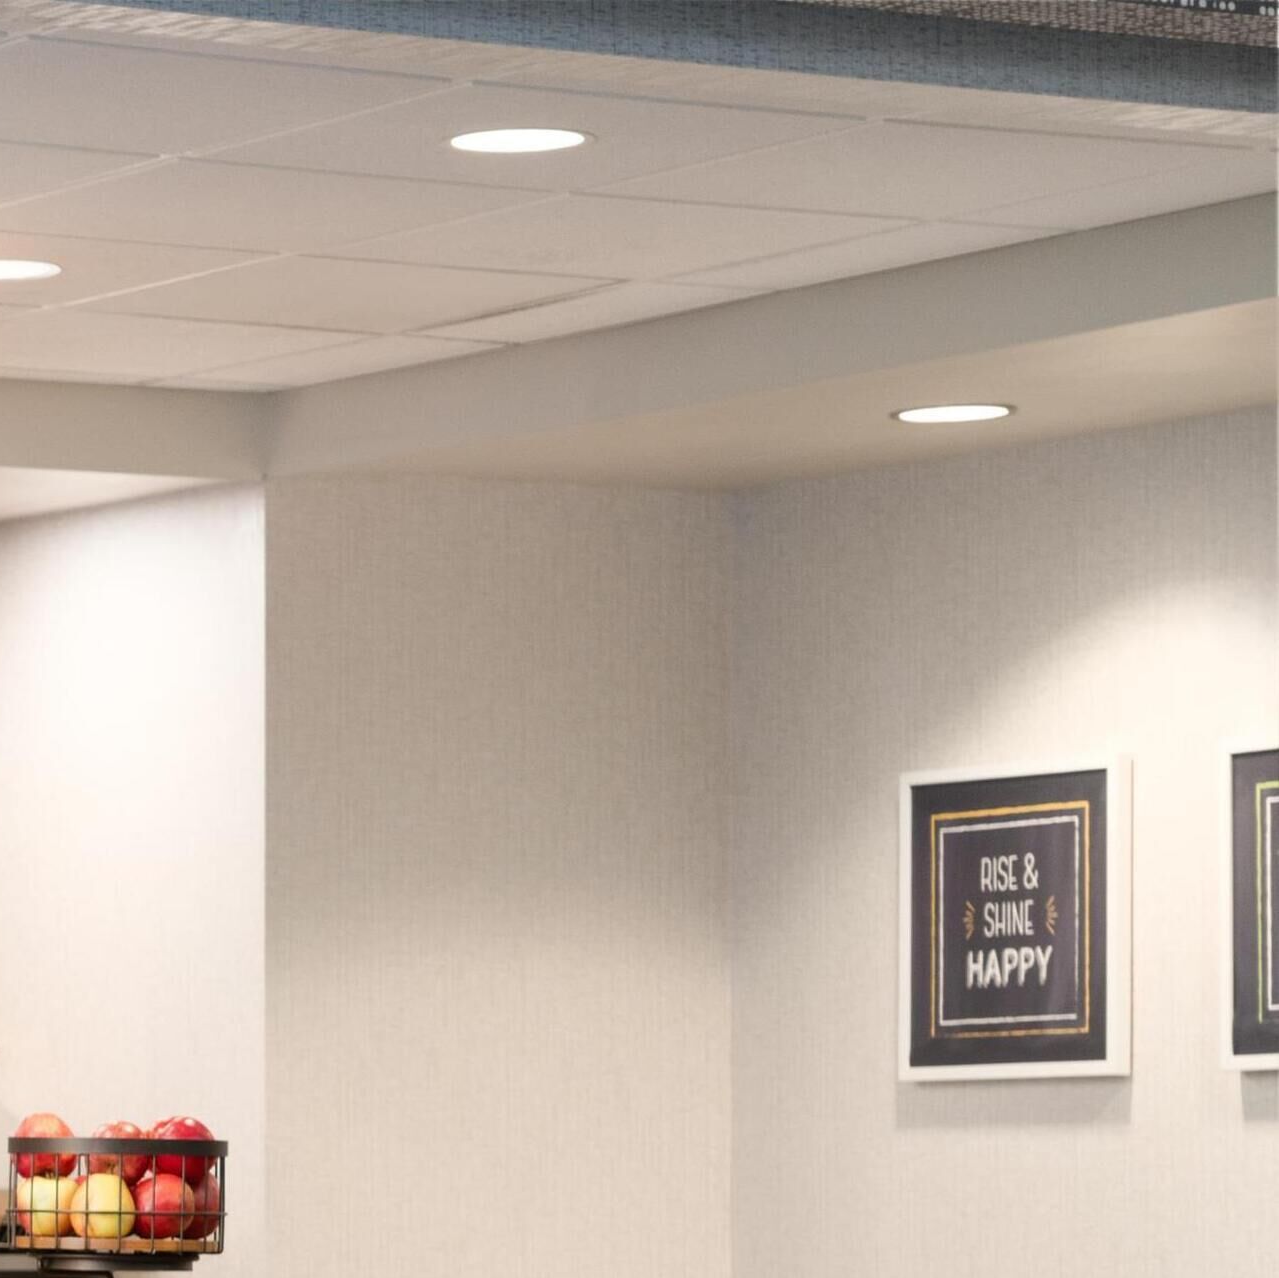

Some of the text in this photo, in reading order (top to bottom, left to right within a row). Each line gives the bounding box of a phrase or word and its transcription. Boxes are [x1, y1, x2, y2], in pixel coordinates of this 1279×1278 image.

[980, 852, 1039, 893] RISE &
[983, 899, 1034, 939] SHINE
[966, 945, 1053, 990] HAPPY
